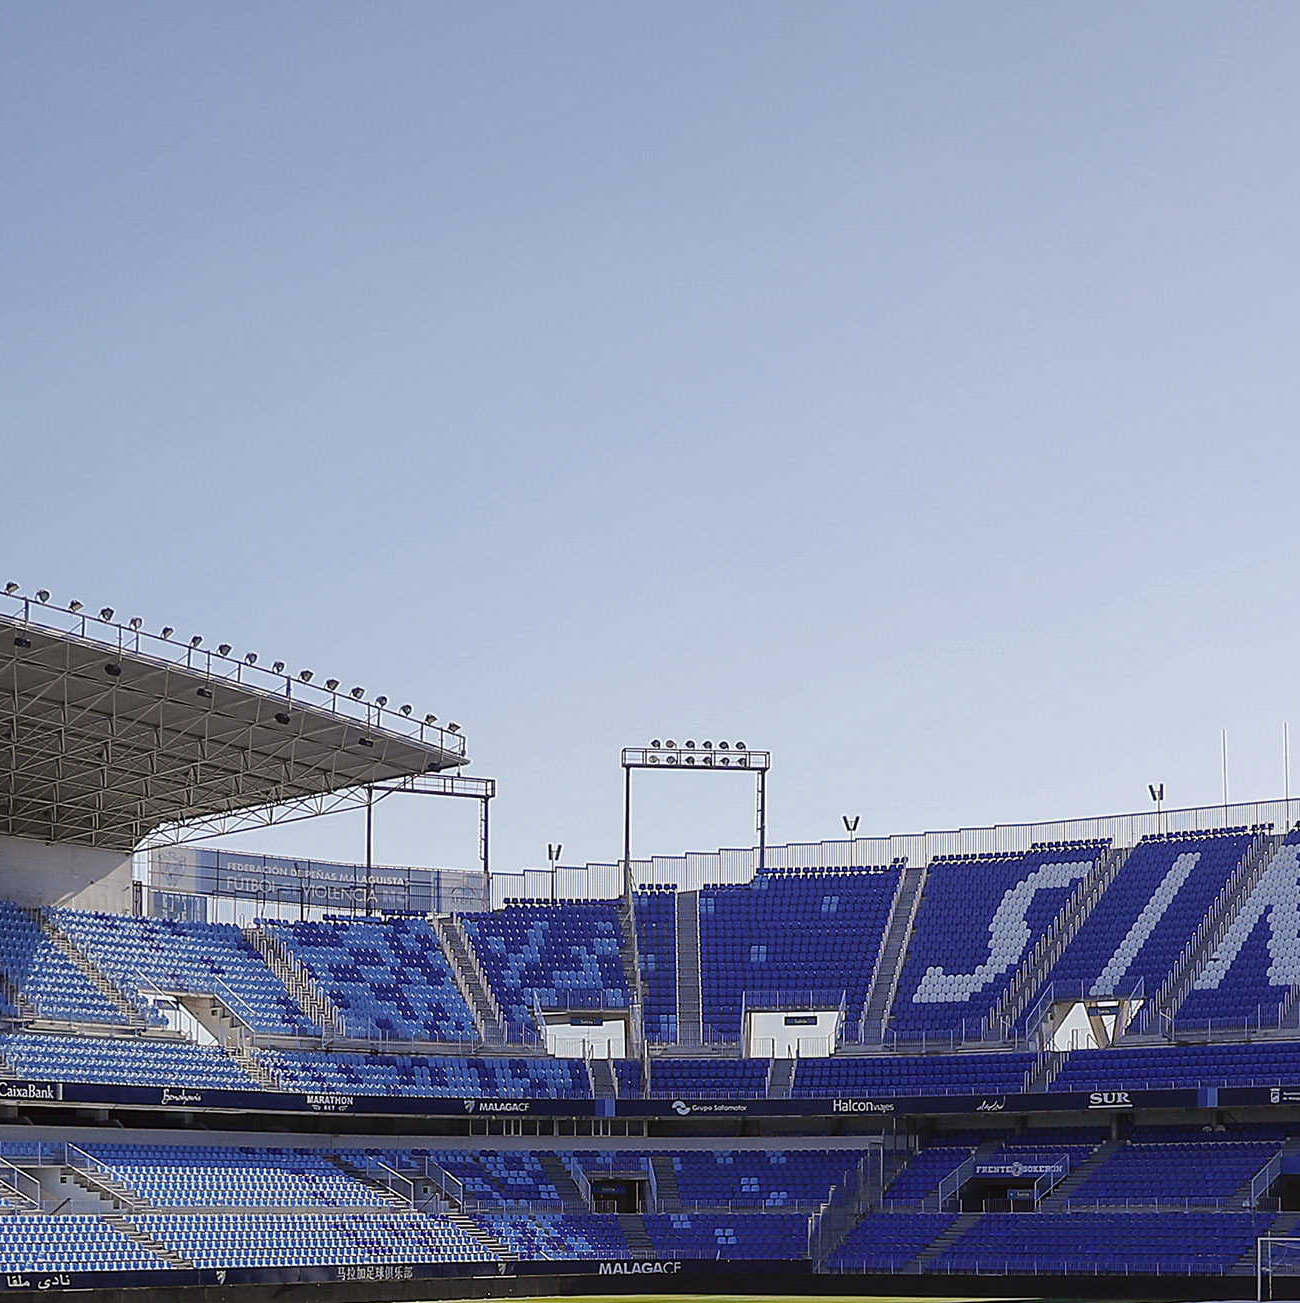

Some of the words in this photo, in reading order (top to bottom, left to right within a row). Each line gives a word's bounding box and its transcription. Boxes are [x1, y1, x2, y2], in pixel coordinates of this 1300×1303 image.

[227, 862, 287, 876] FEDERACIÓN
[305, 869, 337, 880] PEÑAS
[340, 873, 410, 886] MALAGUISTAS
[226, 873, 278, 893] FÚTBOL
[301, 883, 378, 903] VIOLENCIA
[306, 1095, 354, 1105] MARATHON
[1089, 1092, 1131, 1104] SUR
[975, 1165, 1012, 1174] FRENTE
[336, 1265, 414, 1281] 马拉加足球俱乐部
